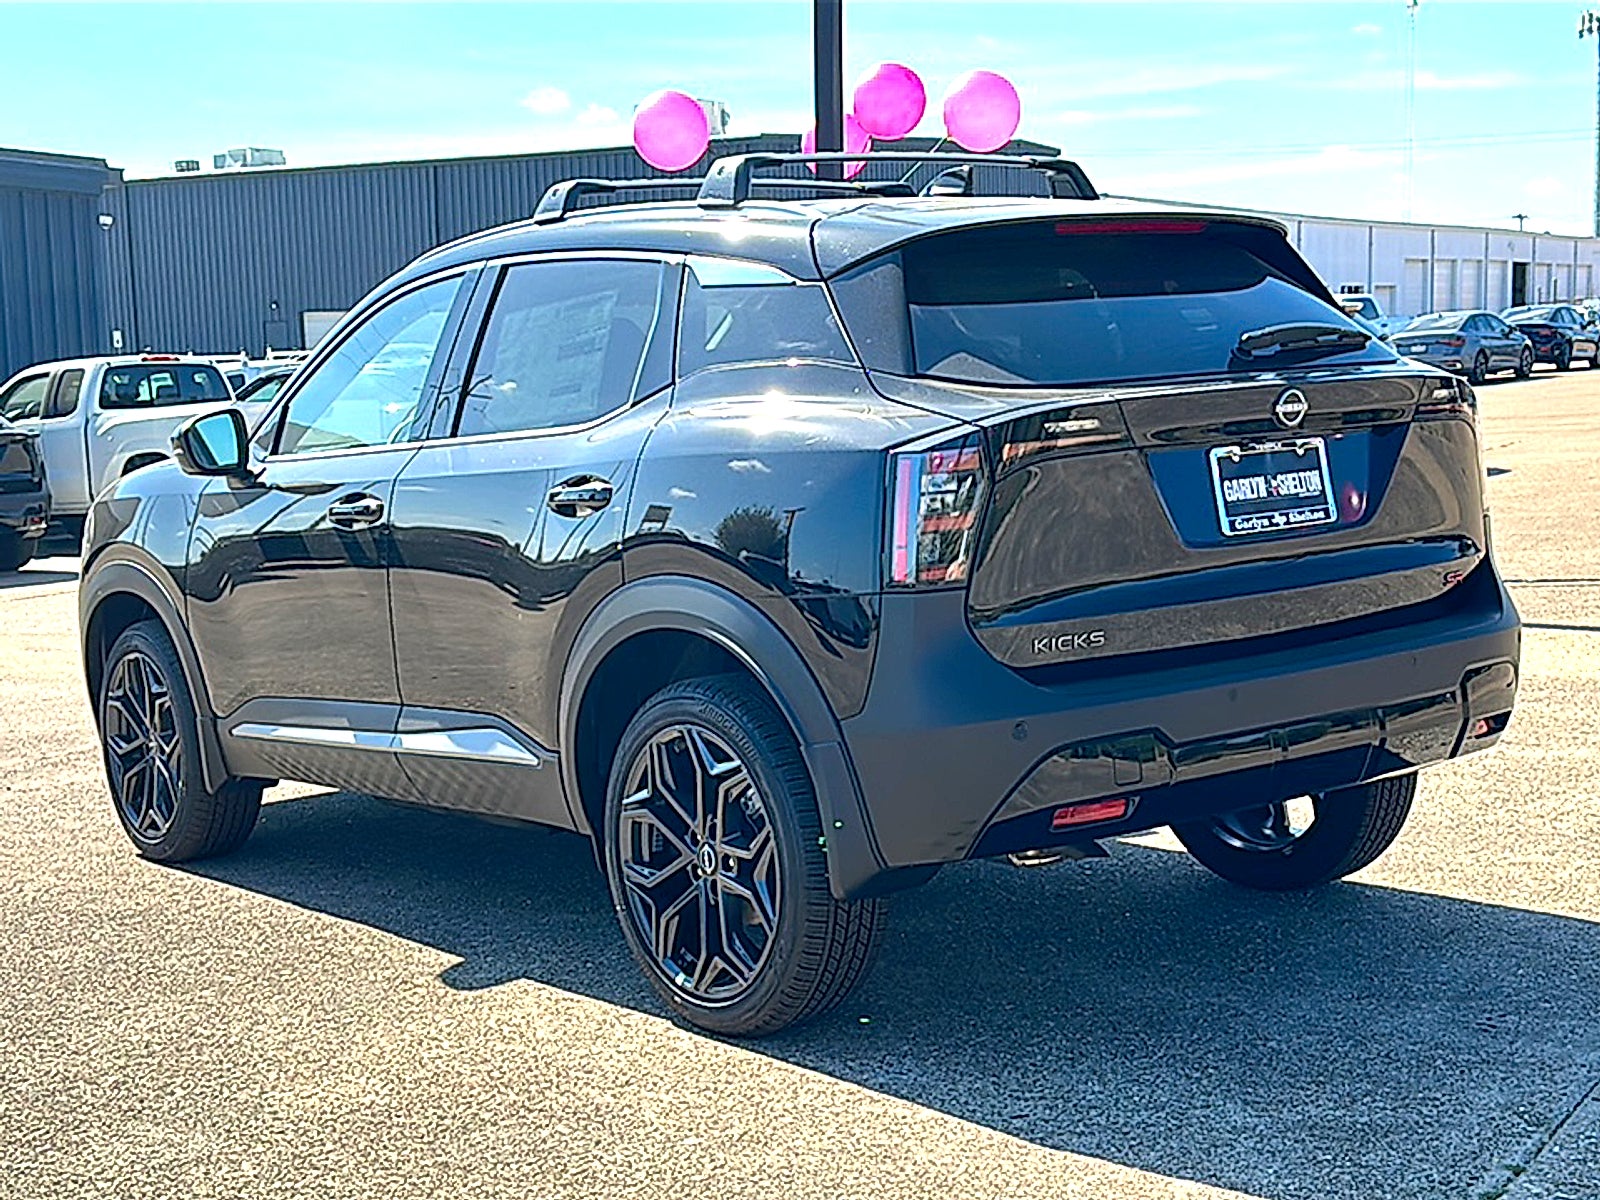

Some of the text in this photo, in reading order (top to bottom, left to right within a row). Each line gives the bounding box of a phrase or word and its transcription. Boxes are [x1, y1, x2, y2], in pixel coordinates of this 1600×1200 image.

[1223, 469, 1322, 502] GARLYN SHELTON
[1032, 630, 1105, 654] KICKS
